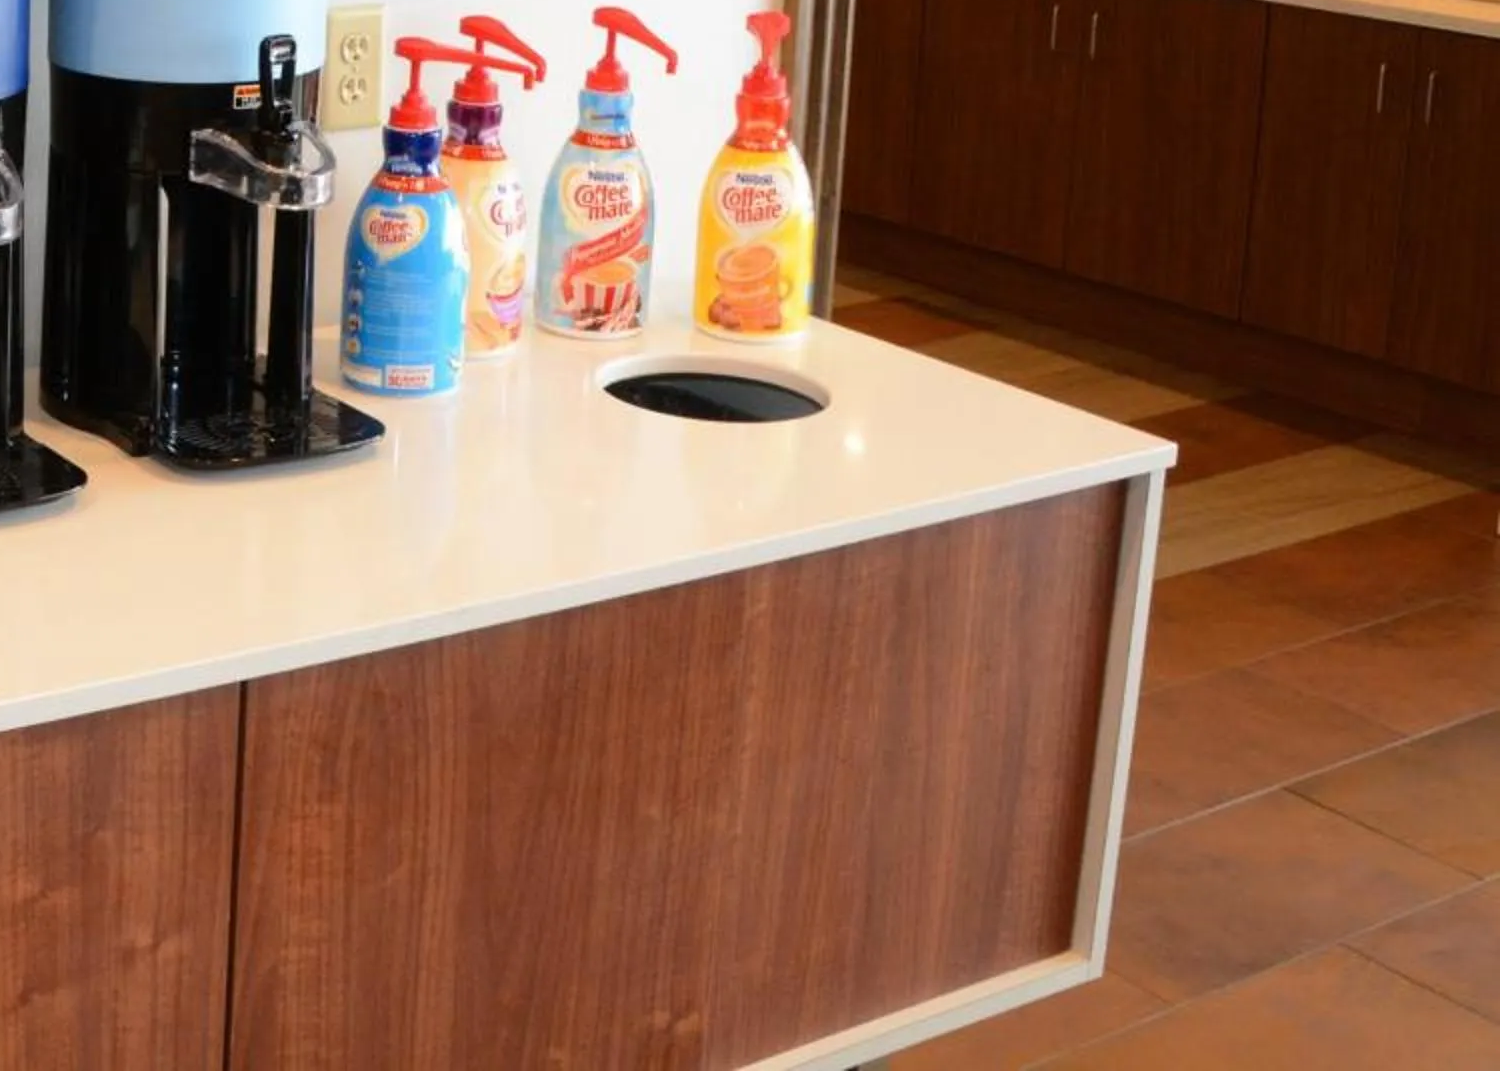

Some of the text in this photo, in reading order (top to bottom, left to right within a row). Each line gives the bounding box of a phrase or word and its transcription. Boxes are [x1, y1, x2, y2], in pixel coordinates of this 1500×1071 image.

[574, 184, 629, 208] Coffee
[722, 186, 777, 210] Coffee
[587, 200, 633, 222] mate
[735, 204, 782, 224] mate
